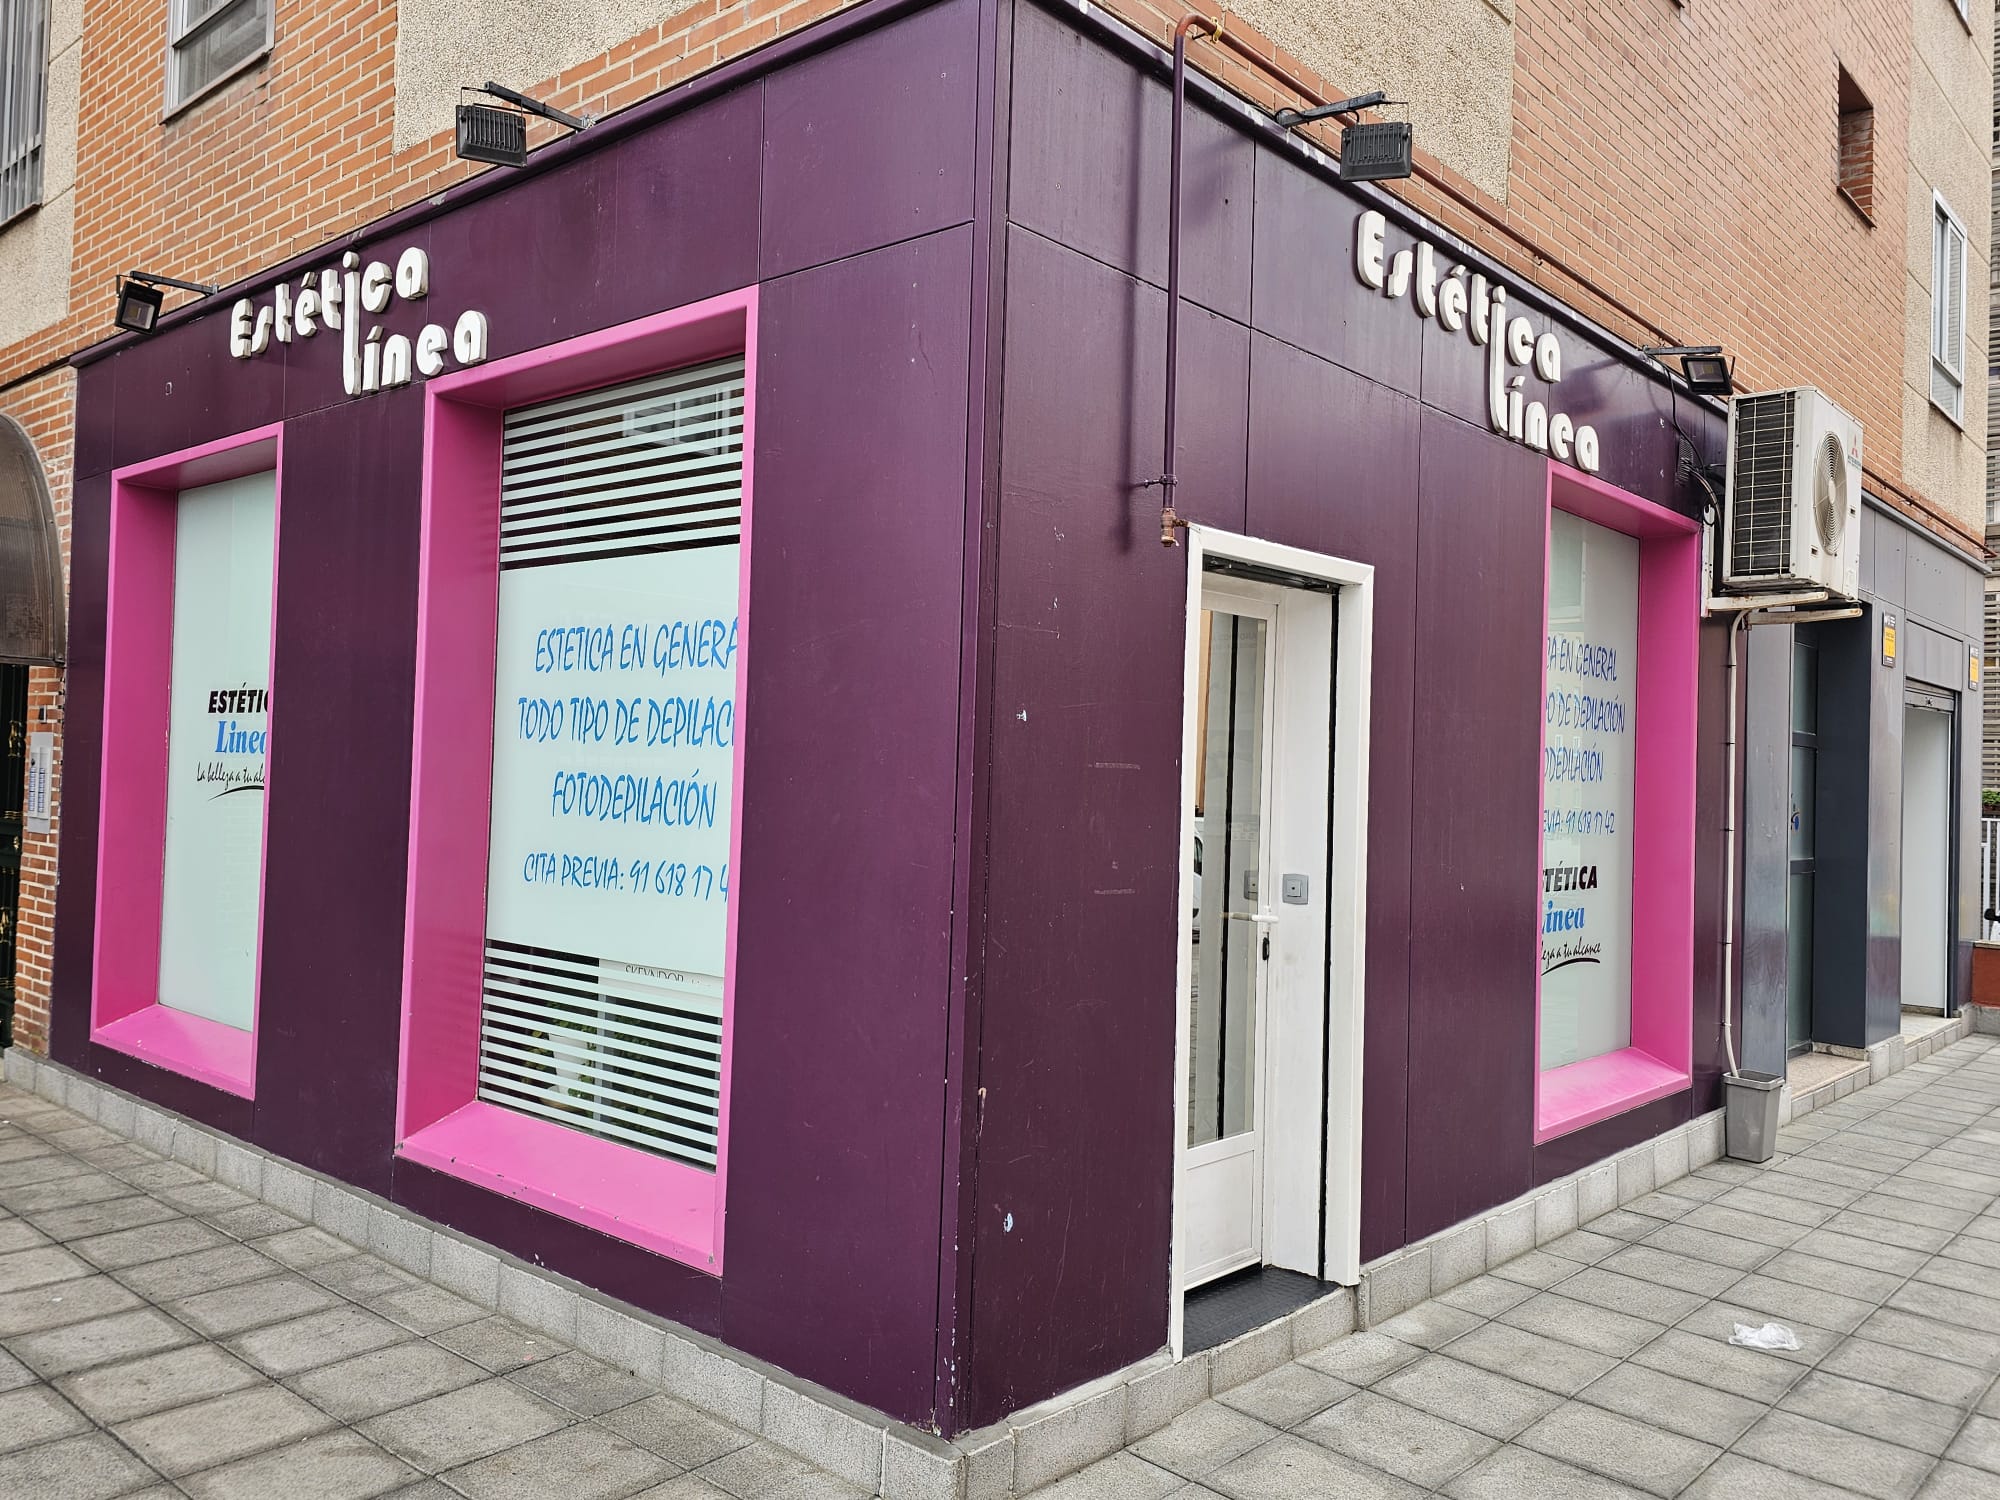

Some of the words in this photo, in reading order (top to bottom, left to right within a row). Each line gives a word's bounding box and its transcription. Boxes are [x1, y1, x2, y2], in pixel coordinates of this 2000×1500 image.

[230, 246, 428, 359] Estética
[1357, 210, 1561, 383] Estética
[535, 623, 614, 673] ESTETICA
[619, 623, 647, 671] EN
[1560, 638, 1574, 673] EN
[1575, 641, 1617, 682] GENERAL
[518, 697, 564, 743] TODO
[570, 696, 609, 744] TIPO
[614, 697, 642, 745] DE
[1558, 691, 1572, 727] DE
[1573, 694, 1626, 734] DEPILACIÓN
[552, 768, 717, 829] FOTODEPILACIÓN
[1566, 809, 1577, 835] 91
[1577, 809, 1593, 835] 618
[1604, 810, 1615, 836] 42
[524, 853, 557, 885] CITA
[561, 854, 625, 891] PREVIA:
[629, 859, 650, 893] 91
[655, 860, 687, 897] 618
[692, 864, 713, 902] 17
[1542, 861, 1598, 893] TÉTICA
